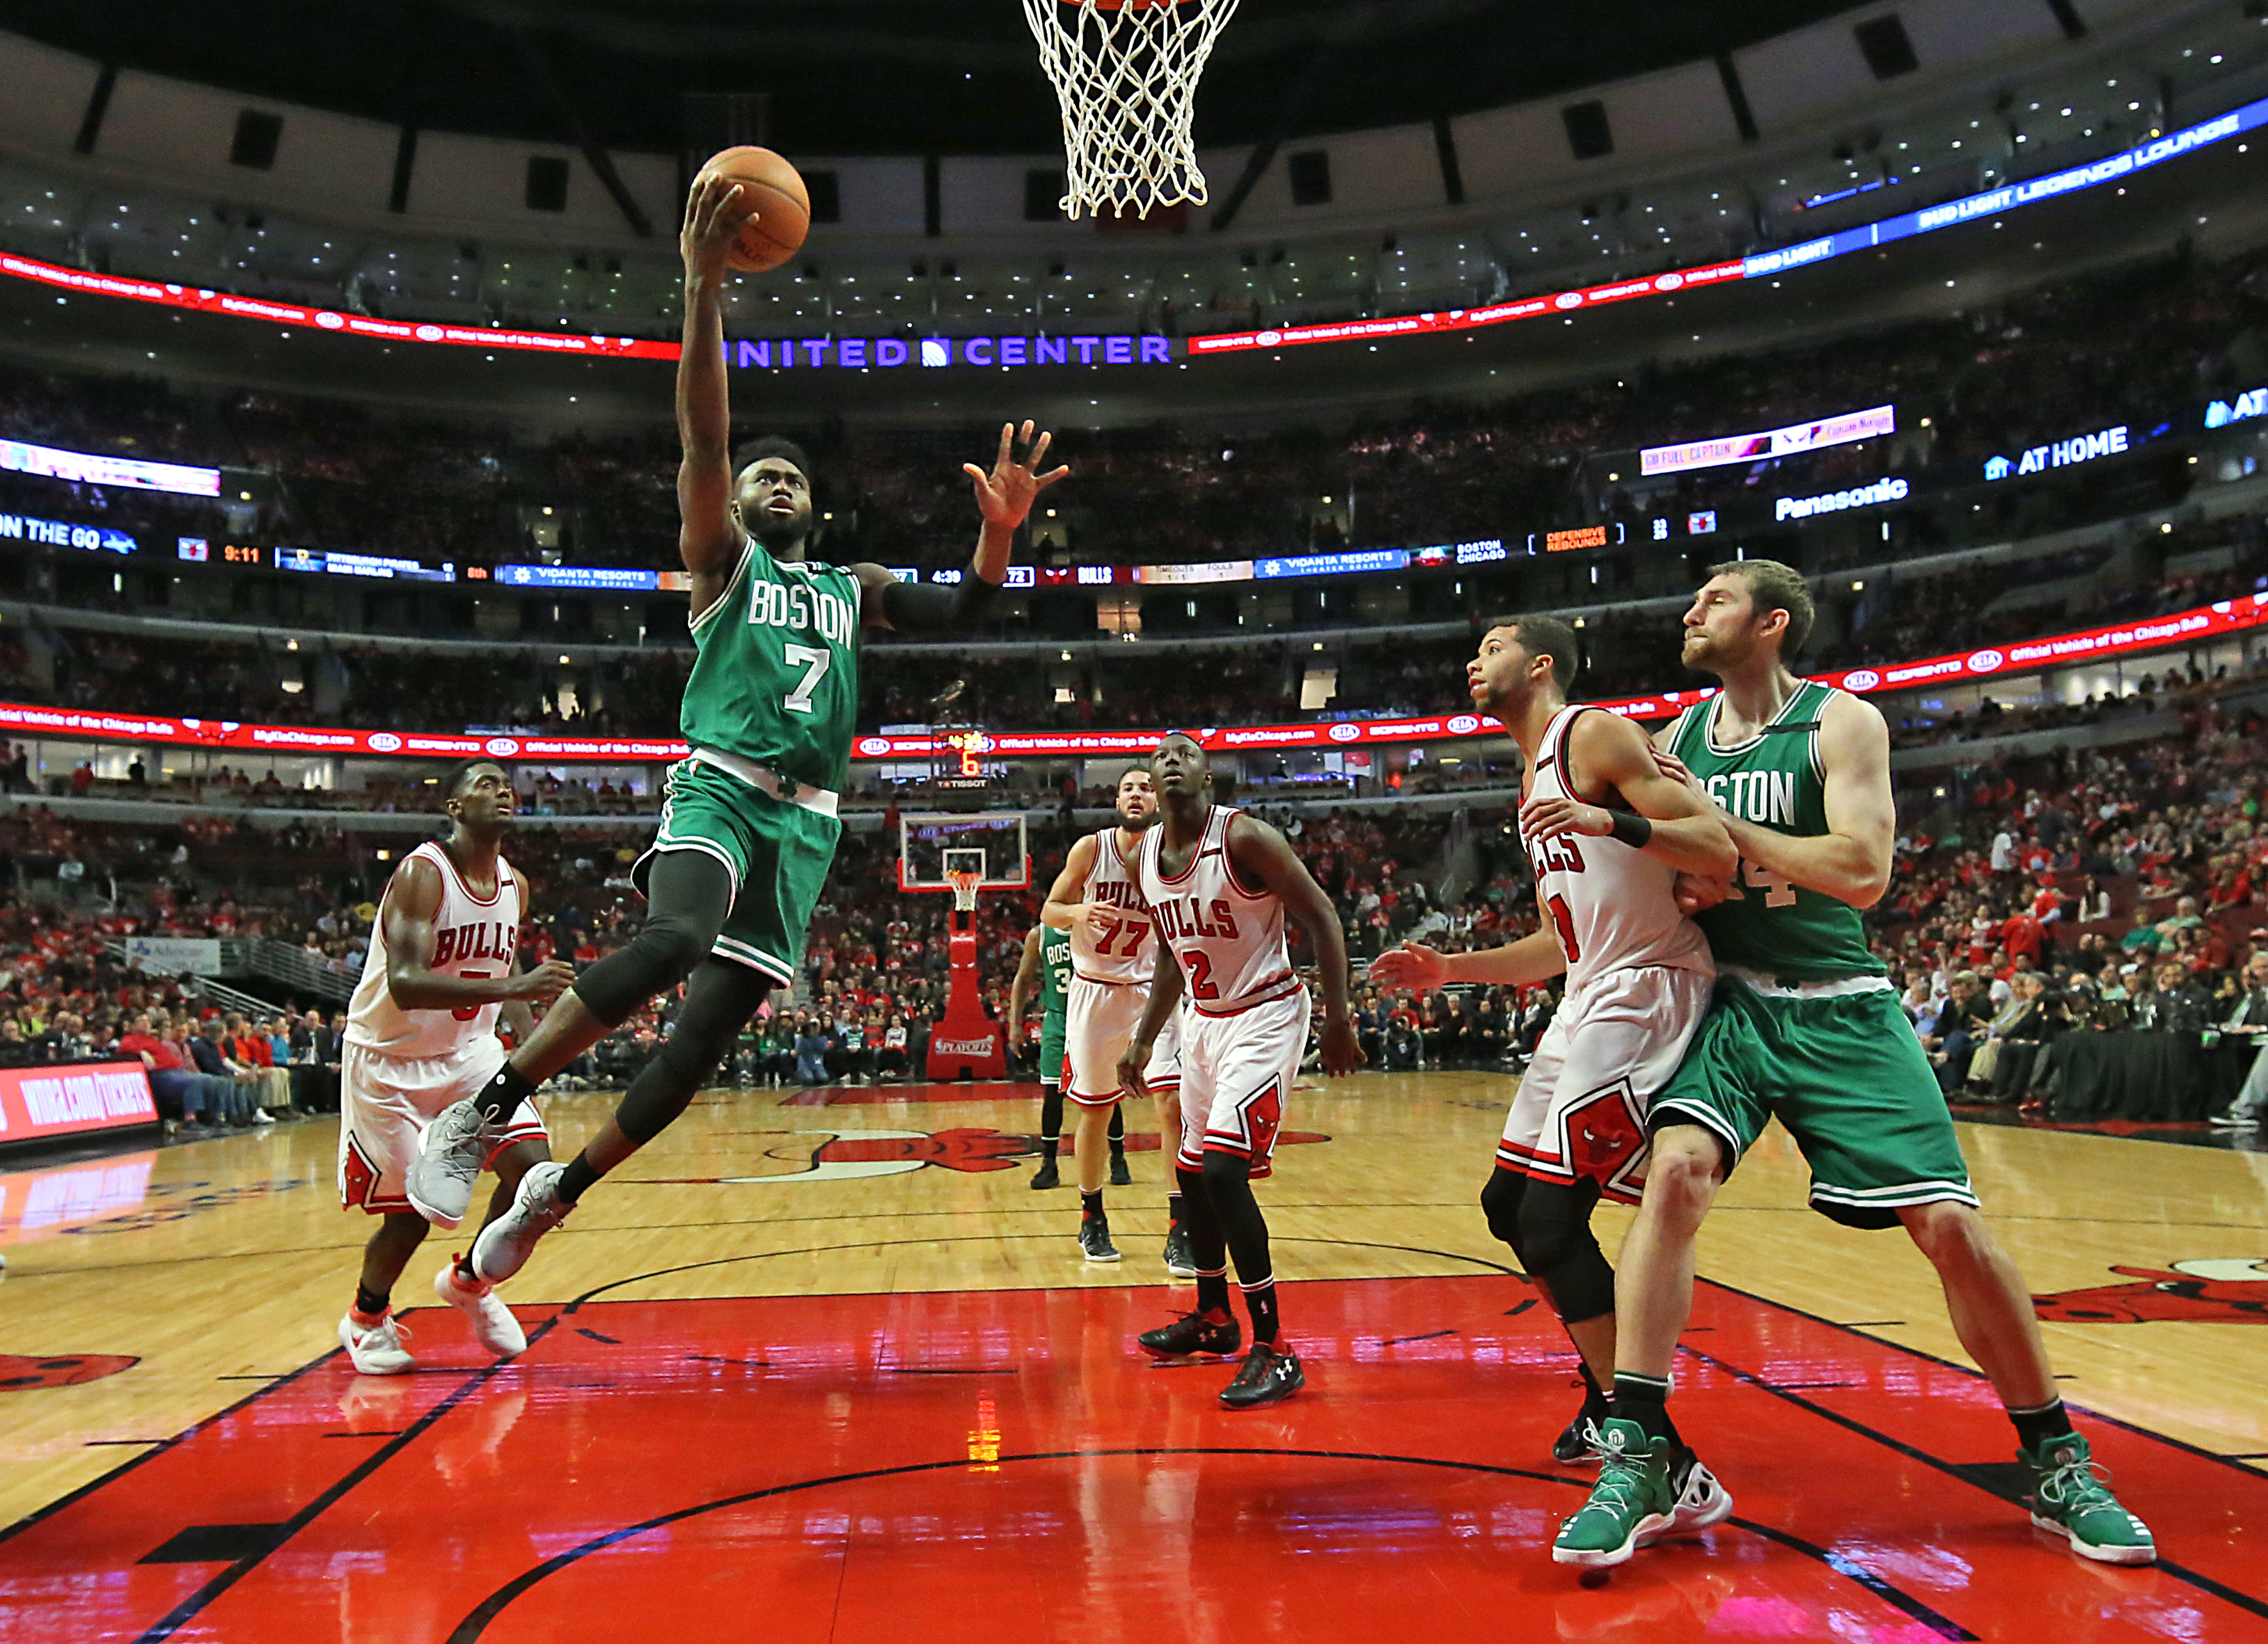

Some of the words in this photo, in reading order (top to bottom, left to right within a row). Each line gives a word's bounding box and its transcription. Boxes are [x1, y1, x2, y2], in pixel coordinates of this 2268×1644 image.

[1919, 205, 1958, 228] BUD
[1958, 190, 2013, 217] LIGHT
[2017, 154, 2133, 201] LEGENDS
[2134, 114, 2240, 167] LOUNGE
[1746, 253, 1782, 274] BUD
[1782, 240, 1831, 266] LIGHT
[963, 336, 1172, 366] CENTER
[2017, 446, 2049, 476] AT
[2052, 425, 2129, 468] HOME
[1776, 477, 1909, 521] Panasonic
[0, 514, 23, 538] N
[25, 518, 70, 546] THE
[72, 527, 100, 550] GO
[1547, 526, 1605, 542] DEFENSIVE
[1457, 540, 1502, 555] BOSTON
[1547, 535, 1607, 552] REBOUNDS
[224, 545, 260, 563] 9:11
[1284, 556, 1338, 567] VIDANTA
[1341, 551, 1393, 564] RESORTS
[1456, 549, 1506, 564] CHICAGO
[535, 567, 591, 578] VIDANTA
[593, 570, 646, 581] RESORTS
[931, 570, 961, 584] 4:39
[1007, 570, 1025, 583] 72
[1078, 566, 1112, 584] BULLS
[748, 579, 853, 650] BOSTON
[2010, 643, 2052, 661] Official
[2052, 638, 2094, 655] Vehicle
[2095, 634, 2111, 647] of
[2111, 632, 2134, 645] the
[2134, 623, 2180, 641] Chicago
[2180, 616, 2210, 632] Bulls
[785, 643, 830, 713] 7
[1886, 661, 1962, 683] SORENTO
[1629, 702, 1656, 713] Bulls
[23, 711, 65, 726] Vehicle
[65, 714, 80, 726] of
[80, 714, 102, 729] the
[102, 717, 145, 734] Chicago
[146, 721, 174, 735] Bulls
[1369, 722, 1440, 736] SORENTO
[253, 730, 355, 746] MyKiaChicago.com
[407, 739, 481, 752] SORENTO
[999, 739, 1034, 749] Official
[1034, 739, 1069, 749] Vehicle
[1069, 737, 1081, 748] of
[1081, 737, 1099, 746] the
[1099, 737, 1137, 748] Chicago
[1225, 729, 1316, 744] MyKiaChicago.com
[526, 741, 563, 753] Official
[562, 742, 599, 753] Vehicle
[599, 742, 613, 753] of
[613, 743, 631, 754] the
[631, 744, 670, 755] Chicago
[962, 750, 980, 776] 6
[952, 779, 986, 788] TISSOT
[1697, 770, 1795, 827] STON
[1095, 881, 1149, 916] BULL
[1095, 918, 1151, 957] 77
[1182, 950, 1220, 1000] 2
[943, 1042, 993, 1053] PLAYOFFS
